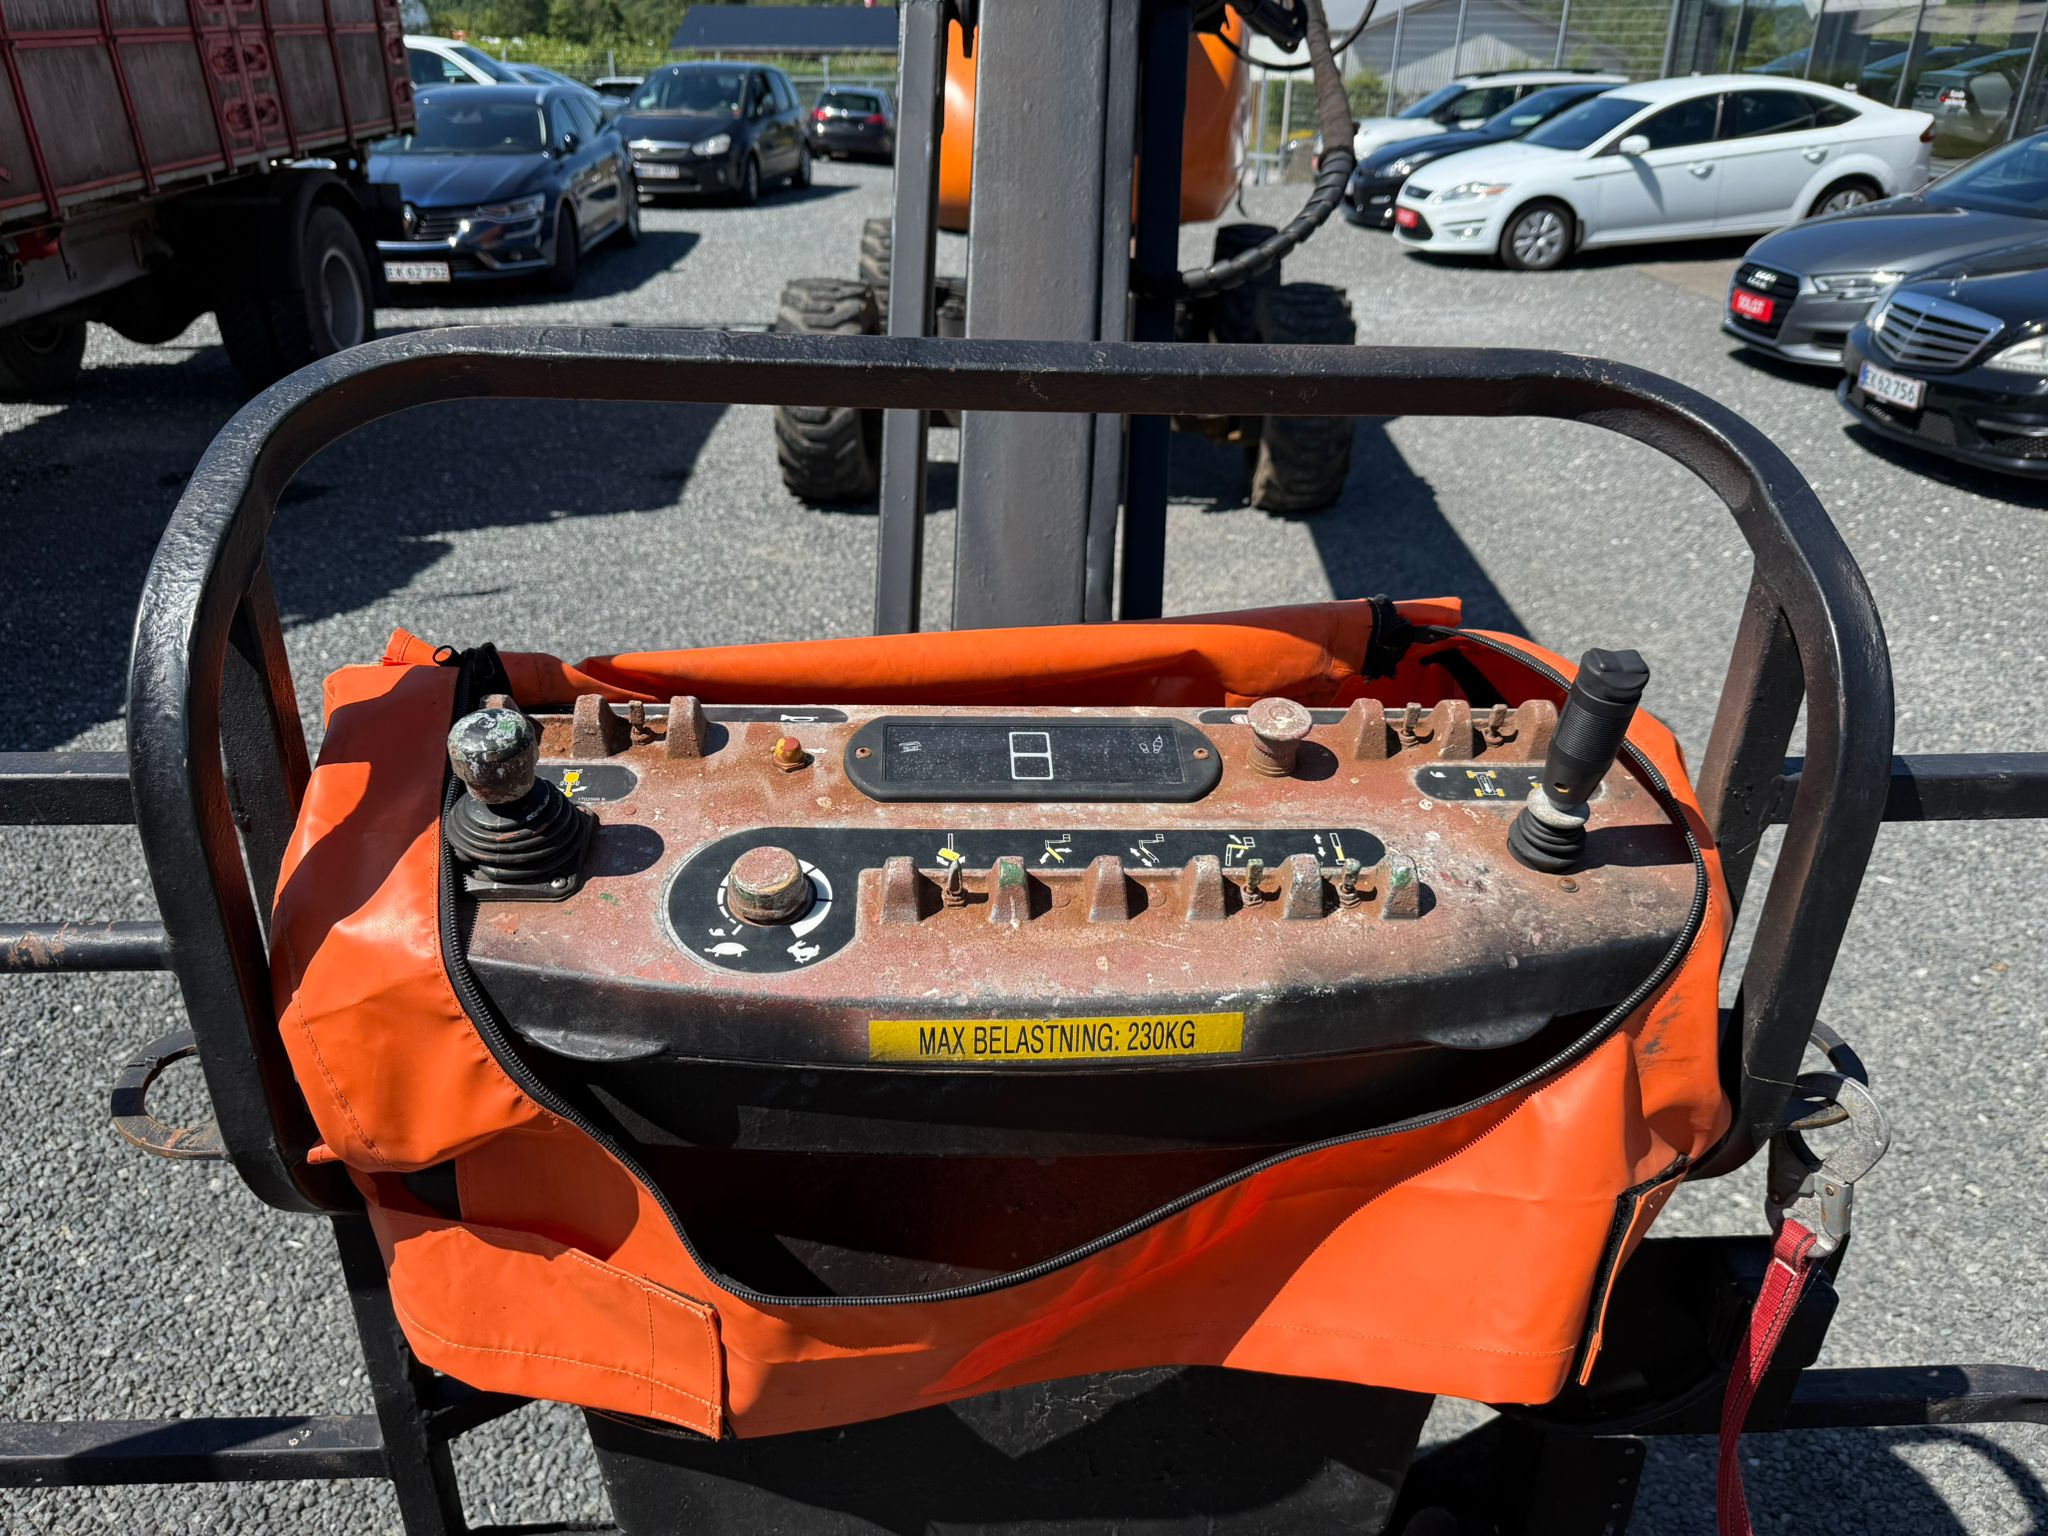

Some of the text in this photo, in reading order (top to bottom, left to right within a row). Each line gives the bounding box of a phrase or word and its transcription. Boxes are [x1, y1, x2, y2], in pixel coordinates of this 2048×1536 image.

[919, 1020, 1195, 1055] MAX BELASTNING: 230KG
